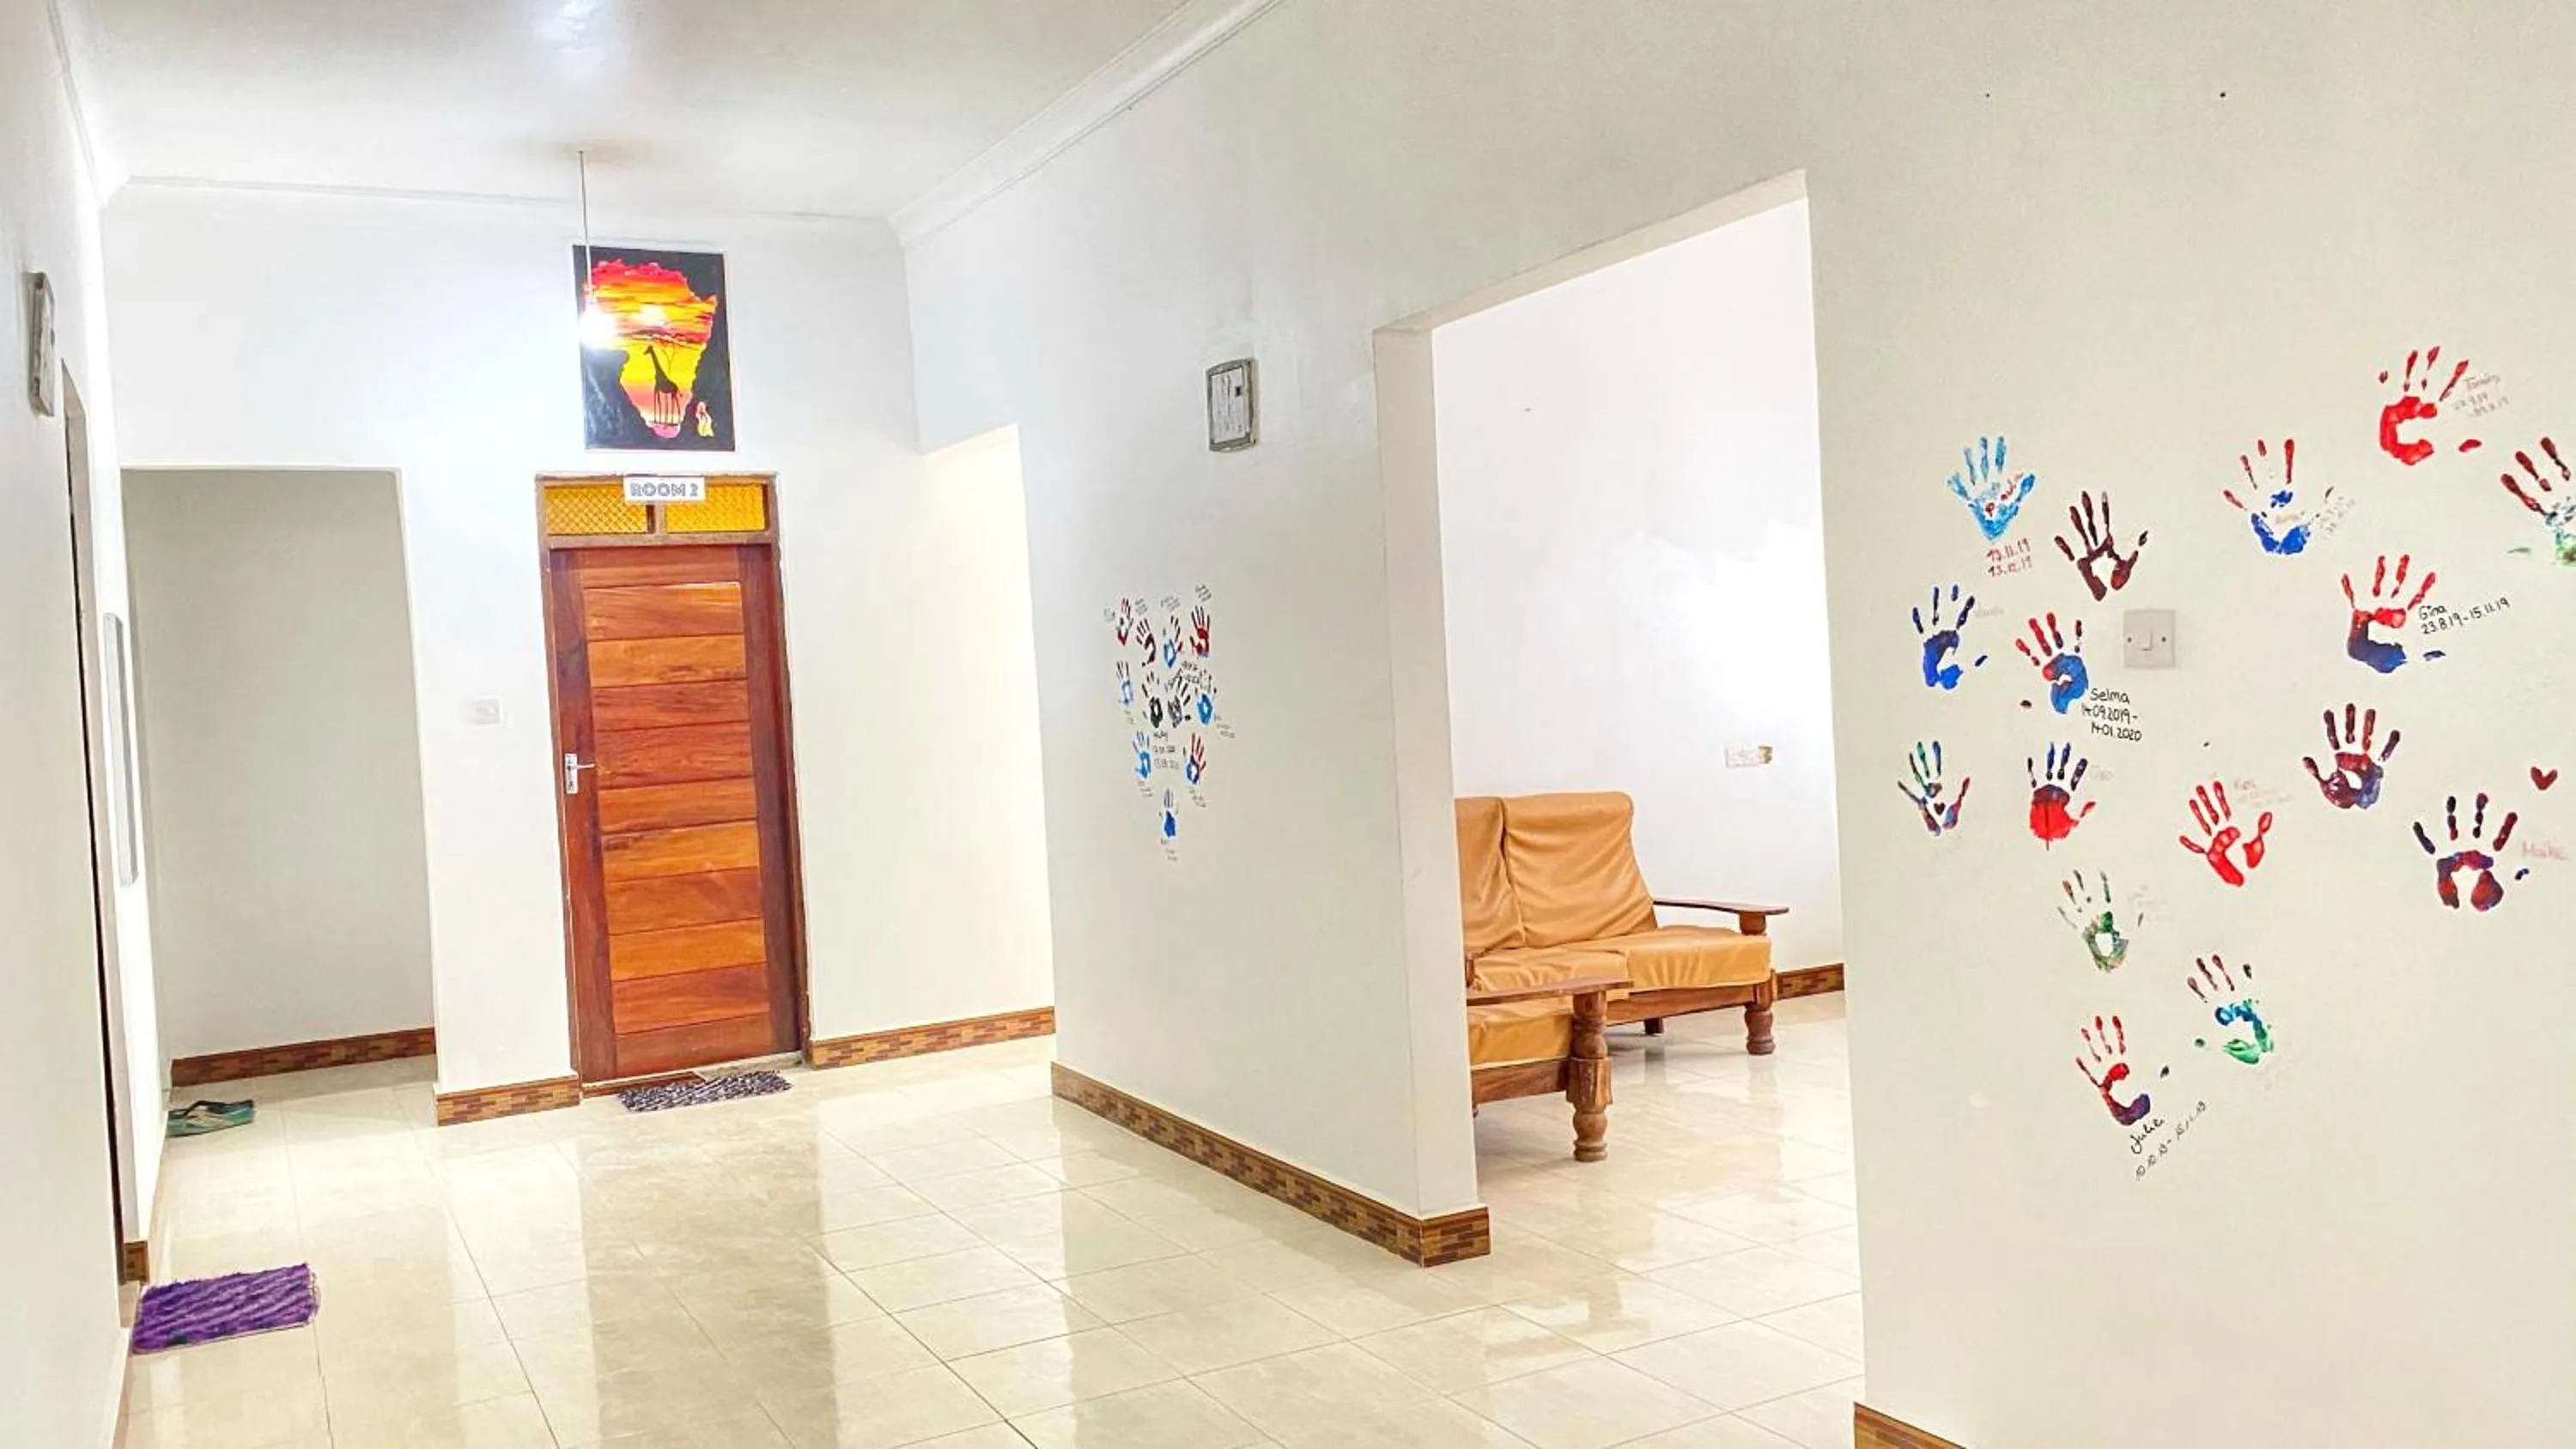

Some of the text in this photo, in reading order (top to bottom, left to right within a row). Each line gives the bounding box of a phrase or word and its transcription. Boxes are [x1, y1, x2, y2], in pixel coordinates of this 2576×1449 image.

[629, 482, 699, 497] ROOM 2
[2417, 603, 2448, 620] Gina
[2089, 687, 2130, 705] Selma
